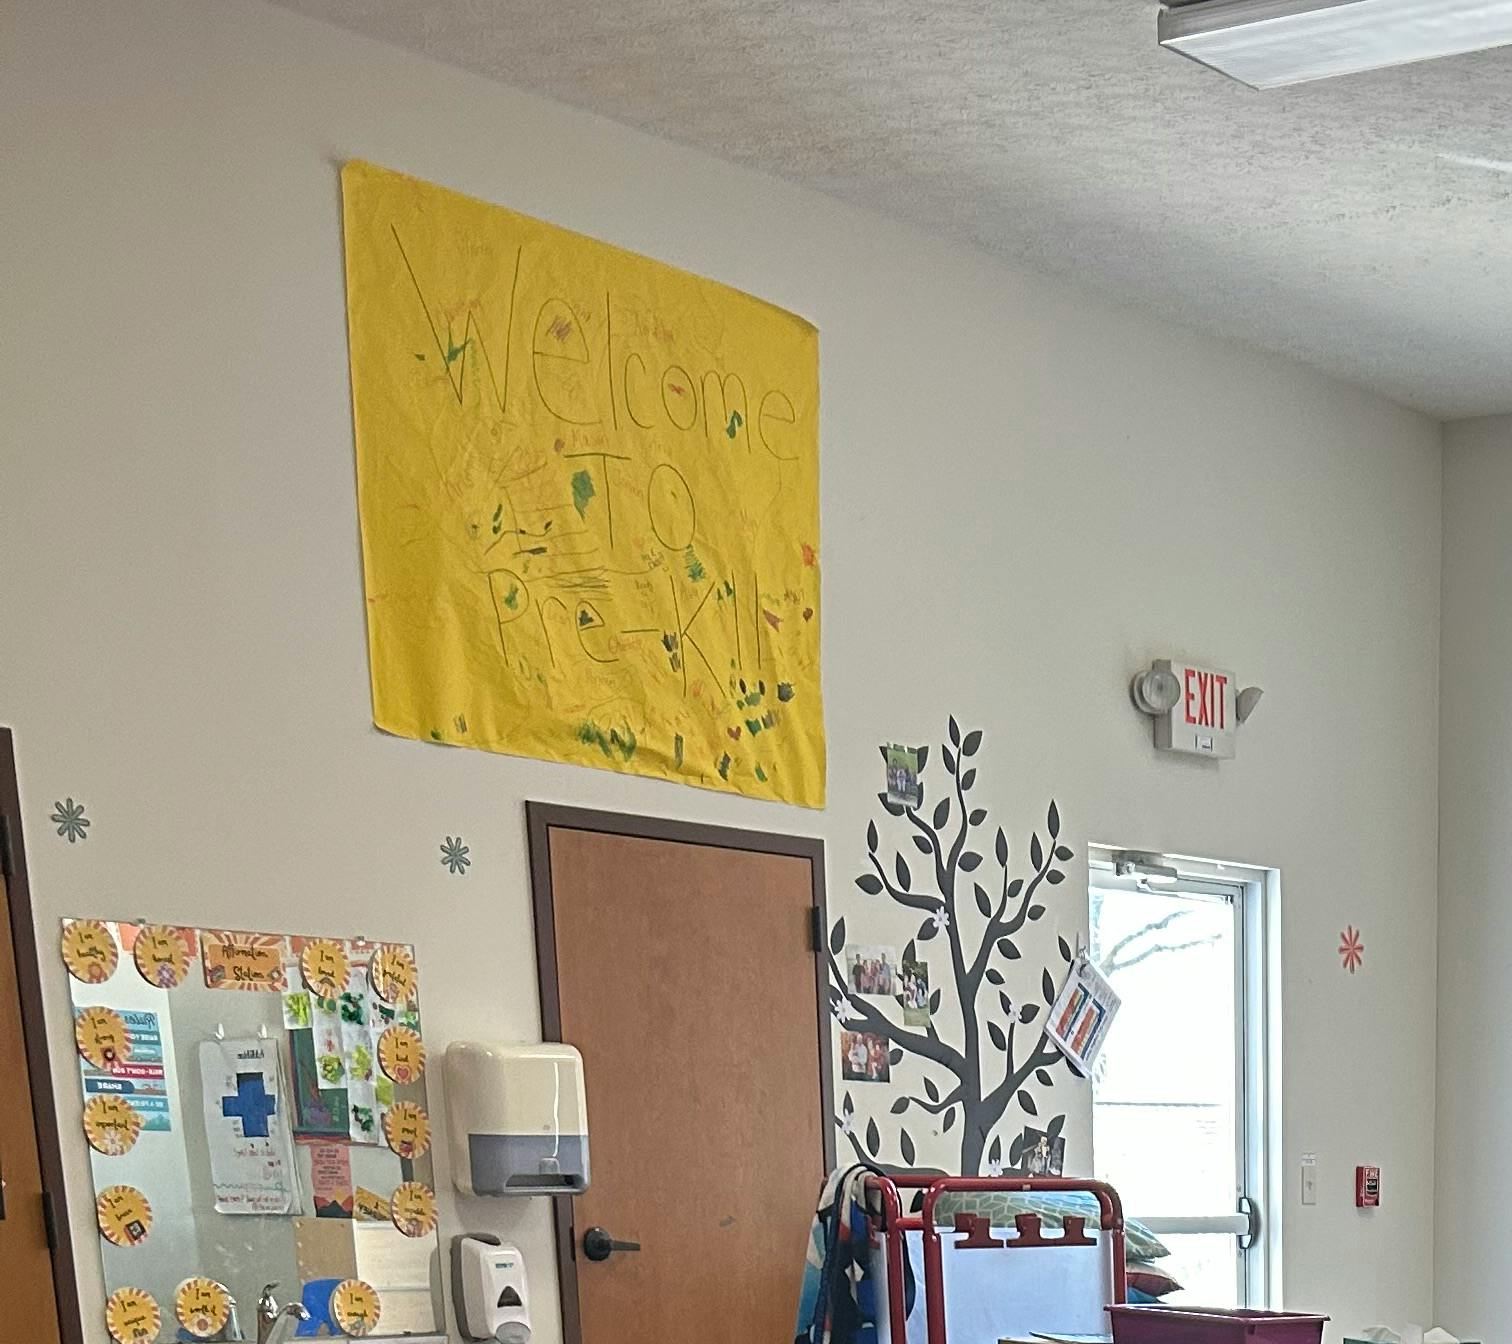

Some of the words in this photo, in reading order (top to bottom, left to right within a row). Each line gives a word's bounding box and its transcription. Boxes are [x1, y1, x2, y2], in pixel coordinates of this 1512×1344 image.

[390, 222, 800, 462] Welcome
[1184, 667, 1228, 730] EXIT
[222, 944, 268, 958] Affirmation
[233, 965, 265, 981] Station
